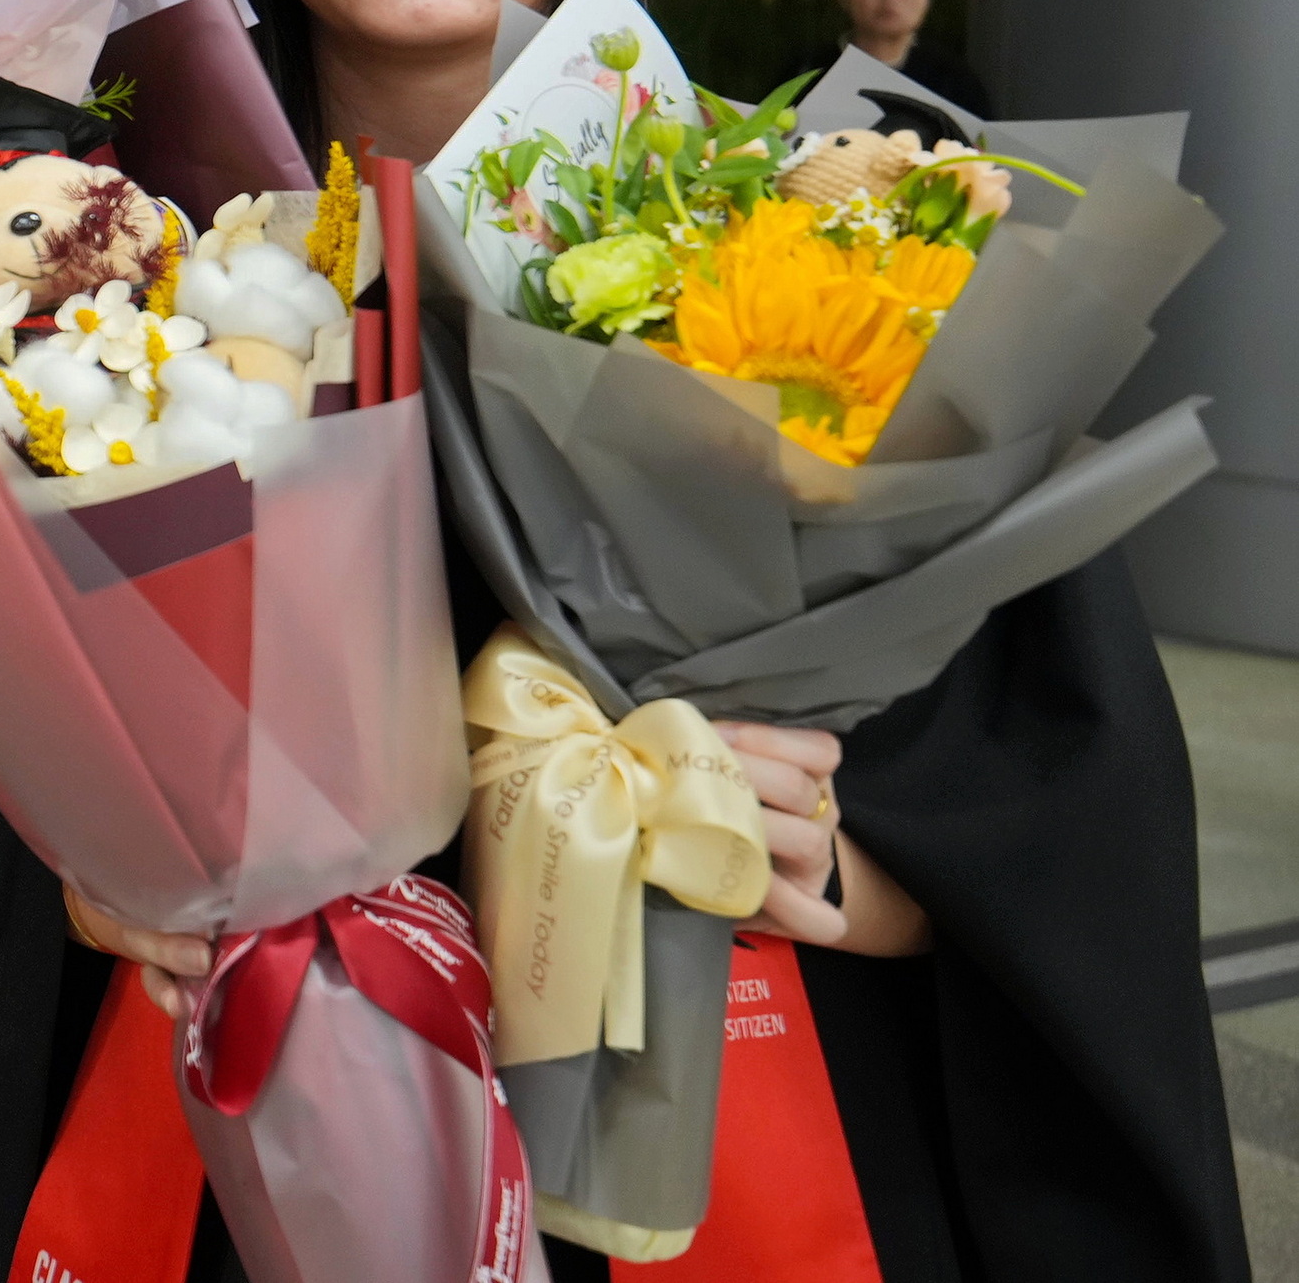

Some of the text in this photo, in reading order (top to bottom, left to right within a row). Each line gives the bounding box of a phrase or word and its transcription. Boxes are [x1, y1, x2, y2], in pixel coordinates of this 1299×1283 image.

[666, 750, 751, 791] Make
[538, 824, 569, 902] Smile
[526, 911, 556, 1002] Today
[724, 1013, 787, 1042] SITIZEN
